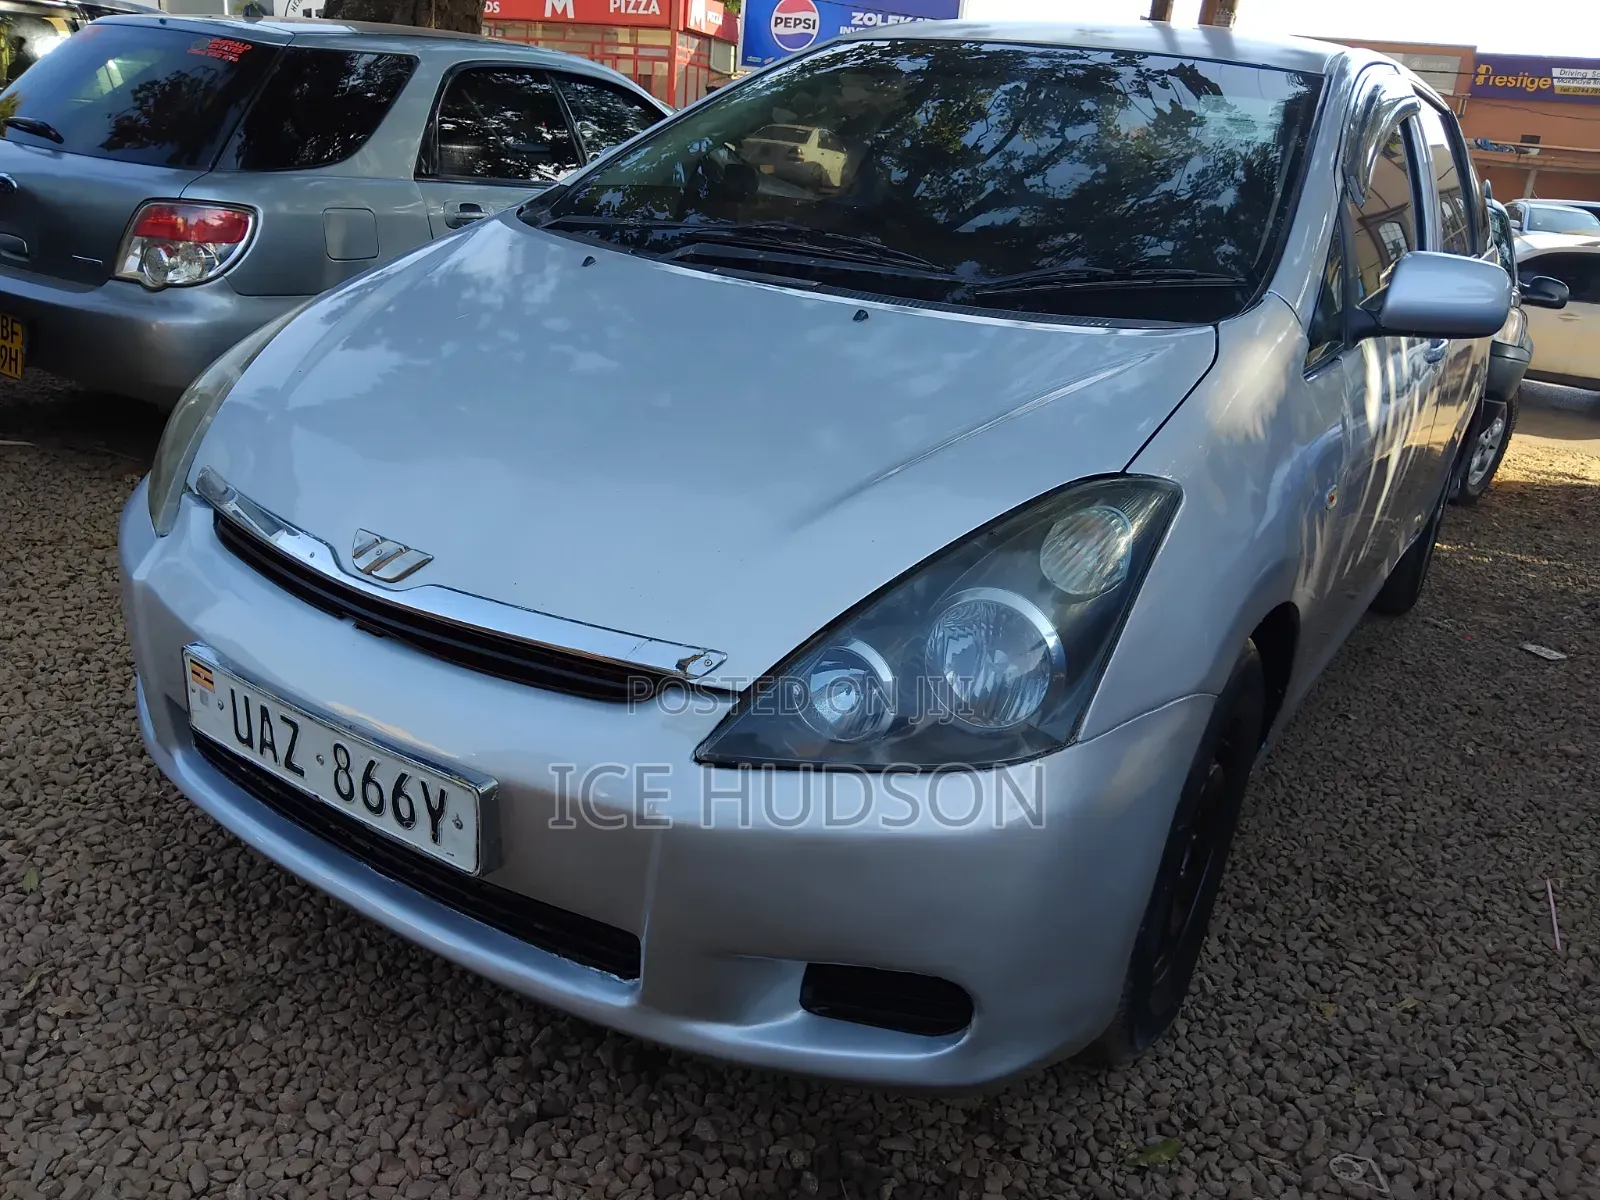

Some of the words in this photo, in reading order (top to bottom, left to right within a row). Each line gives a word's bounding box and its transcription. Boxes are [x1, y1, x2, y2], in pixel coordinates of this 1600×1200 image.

[545, 0, 575, 18] M
[610, 0, 660, 15] PIZZA
[774, 16, 816, 30] PEPSI
[1475, 64, 1552, 91] Prestige
[1560, 69, 1588, 78] Driving
[1, 314, 21, 343] BF
[230, 687, 305, 777] UAZ
[332, 742, 448, 844] 866Y
